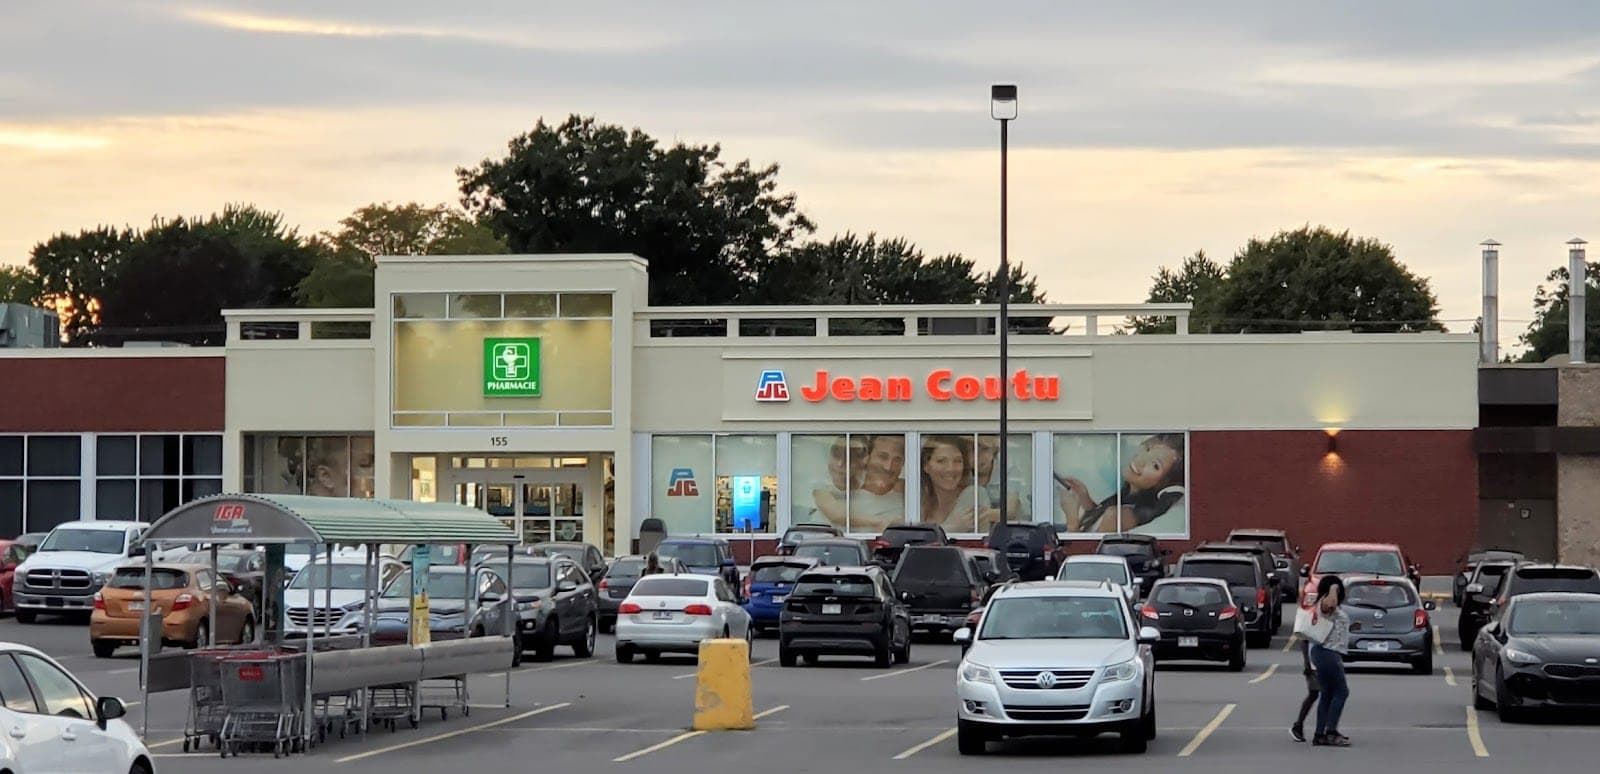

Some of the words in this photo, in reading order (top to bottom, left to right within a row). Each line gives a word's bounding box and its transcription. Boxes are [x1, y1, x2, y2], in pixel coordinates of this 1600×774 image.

[487, 381, 537, 390] PHARMACIE
[800, 369, 912, 402] Jean
[926, 368, 1060, 401] Coutu
[490, 436, 508, 446] 155
[214, 504, 245, 520] IGA
